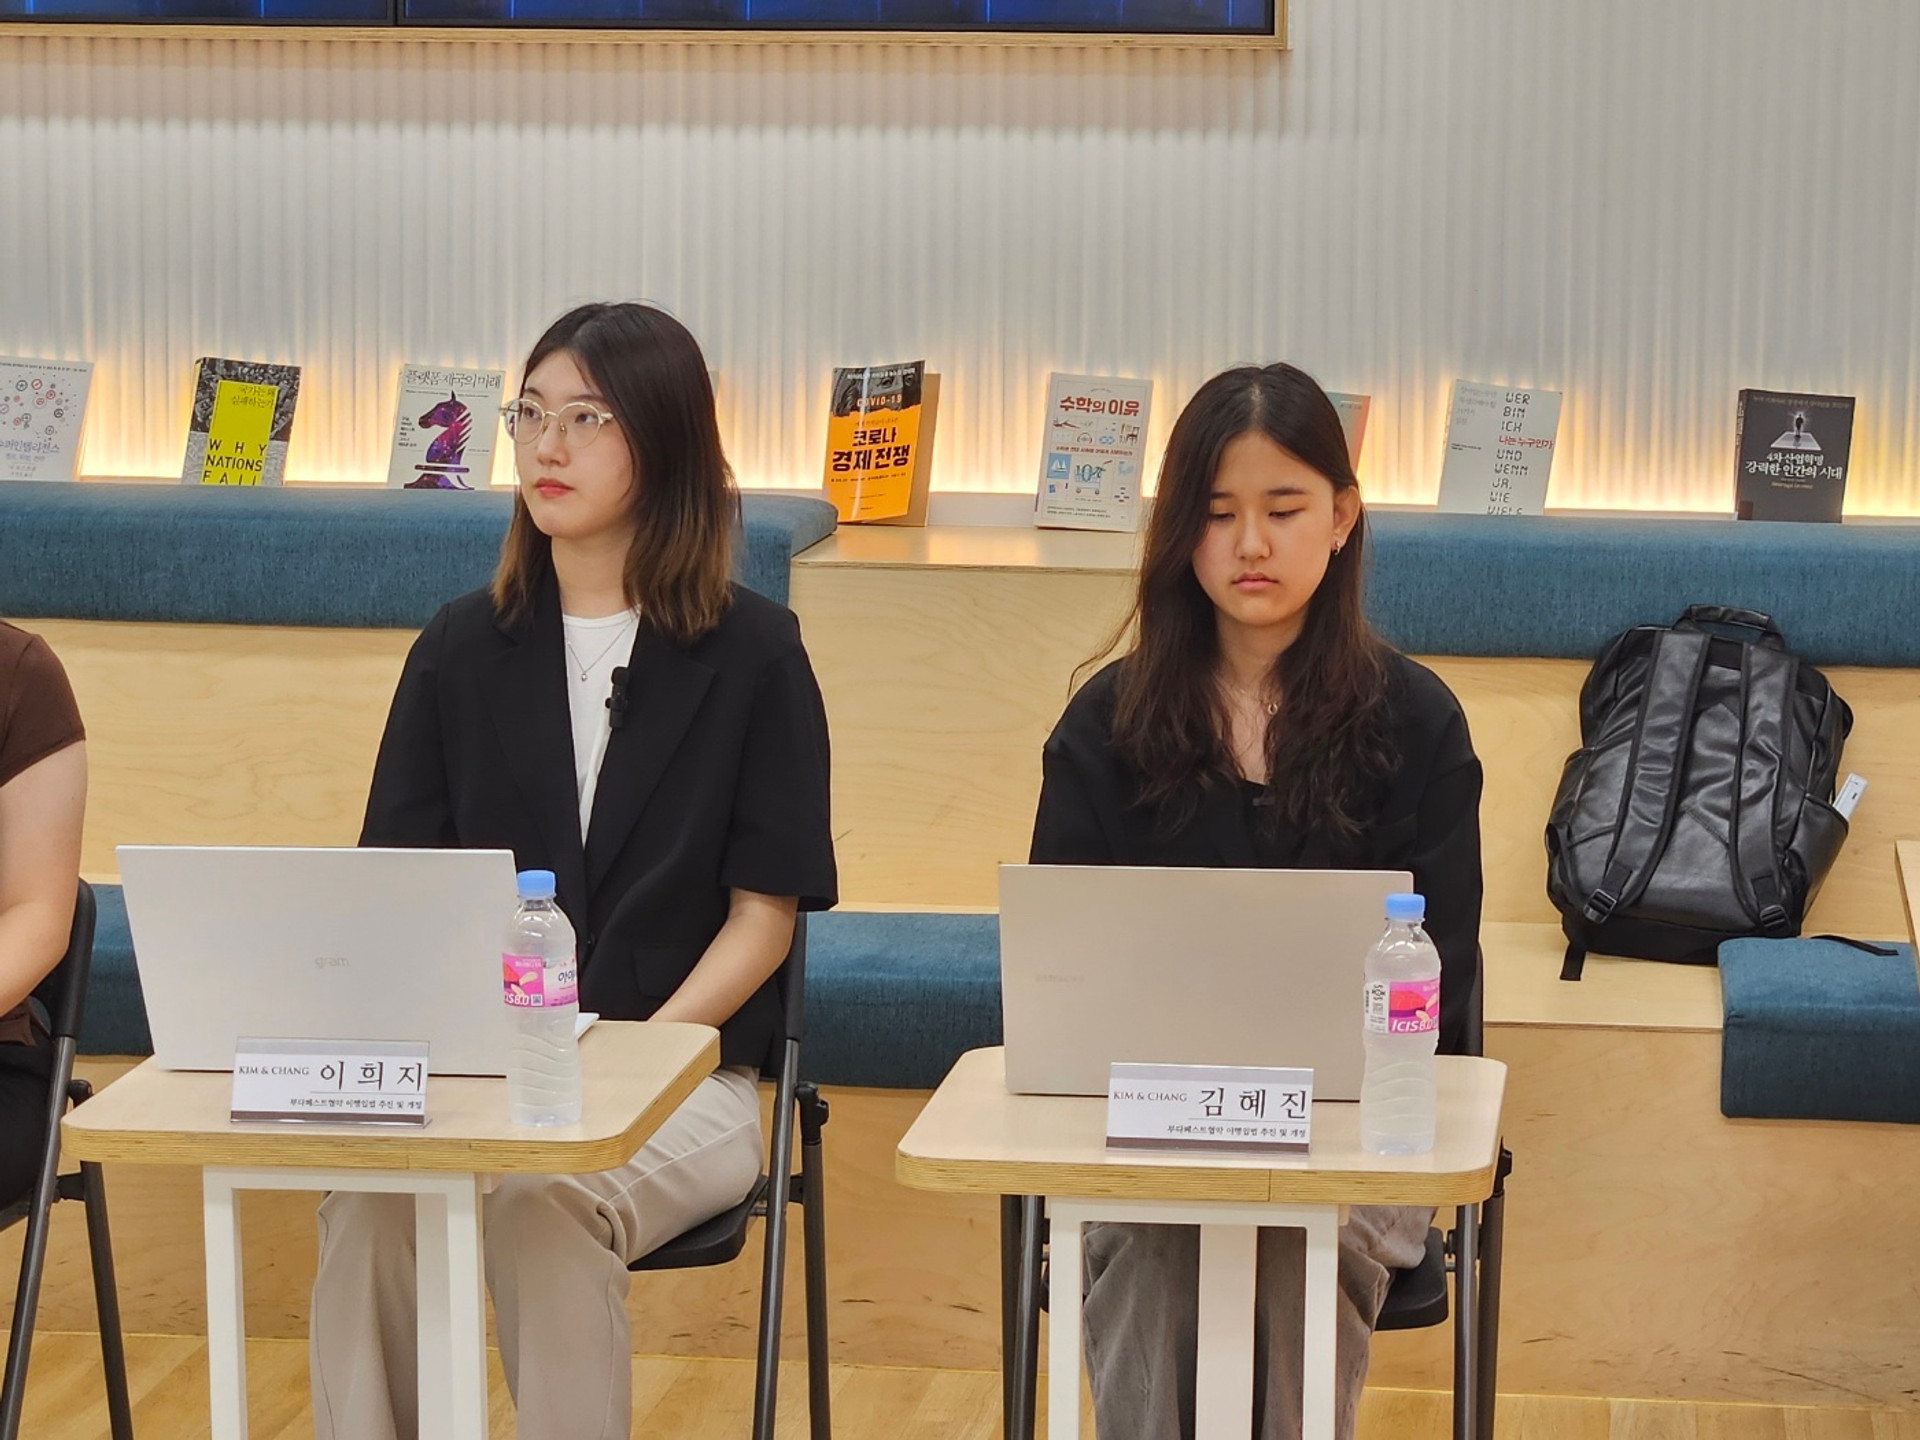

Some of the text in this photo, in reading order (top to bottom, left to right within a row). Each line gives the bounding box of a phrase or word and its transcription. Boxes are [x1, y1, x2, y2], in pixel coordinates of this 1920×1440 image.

[406, 370, 500, 389] 플랫폼 제국의 미래
[857, 394, 902, 407] COVID-19
[1060, 396, 1140, 417] 수학의 이유
[1503, 406, 1525, 418] BIN
[1501, 421, 1522, 432] ICH
[852, 426, 896, 447] 코로나
[1496, 449, 1522, 461] UND
[1766, 452, 1824, 466] 4차 산업혁명
[206, 454, 263, 471] NATIONS
[1745, 461, 1843, 480] 강력한 인간의 시대
[238, 1066, 310, 1076] KIM & CHANG
[1113, 1091, 1188, 1102] KIM & CHANG
